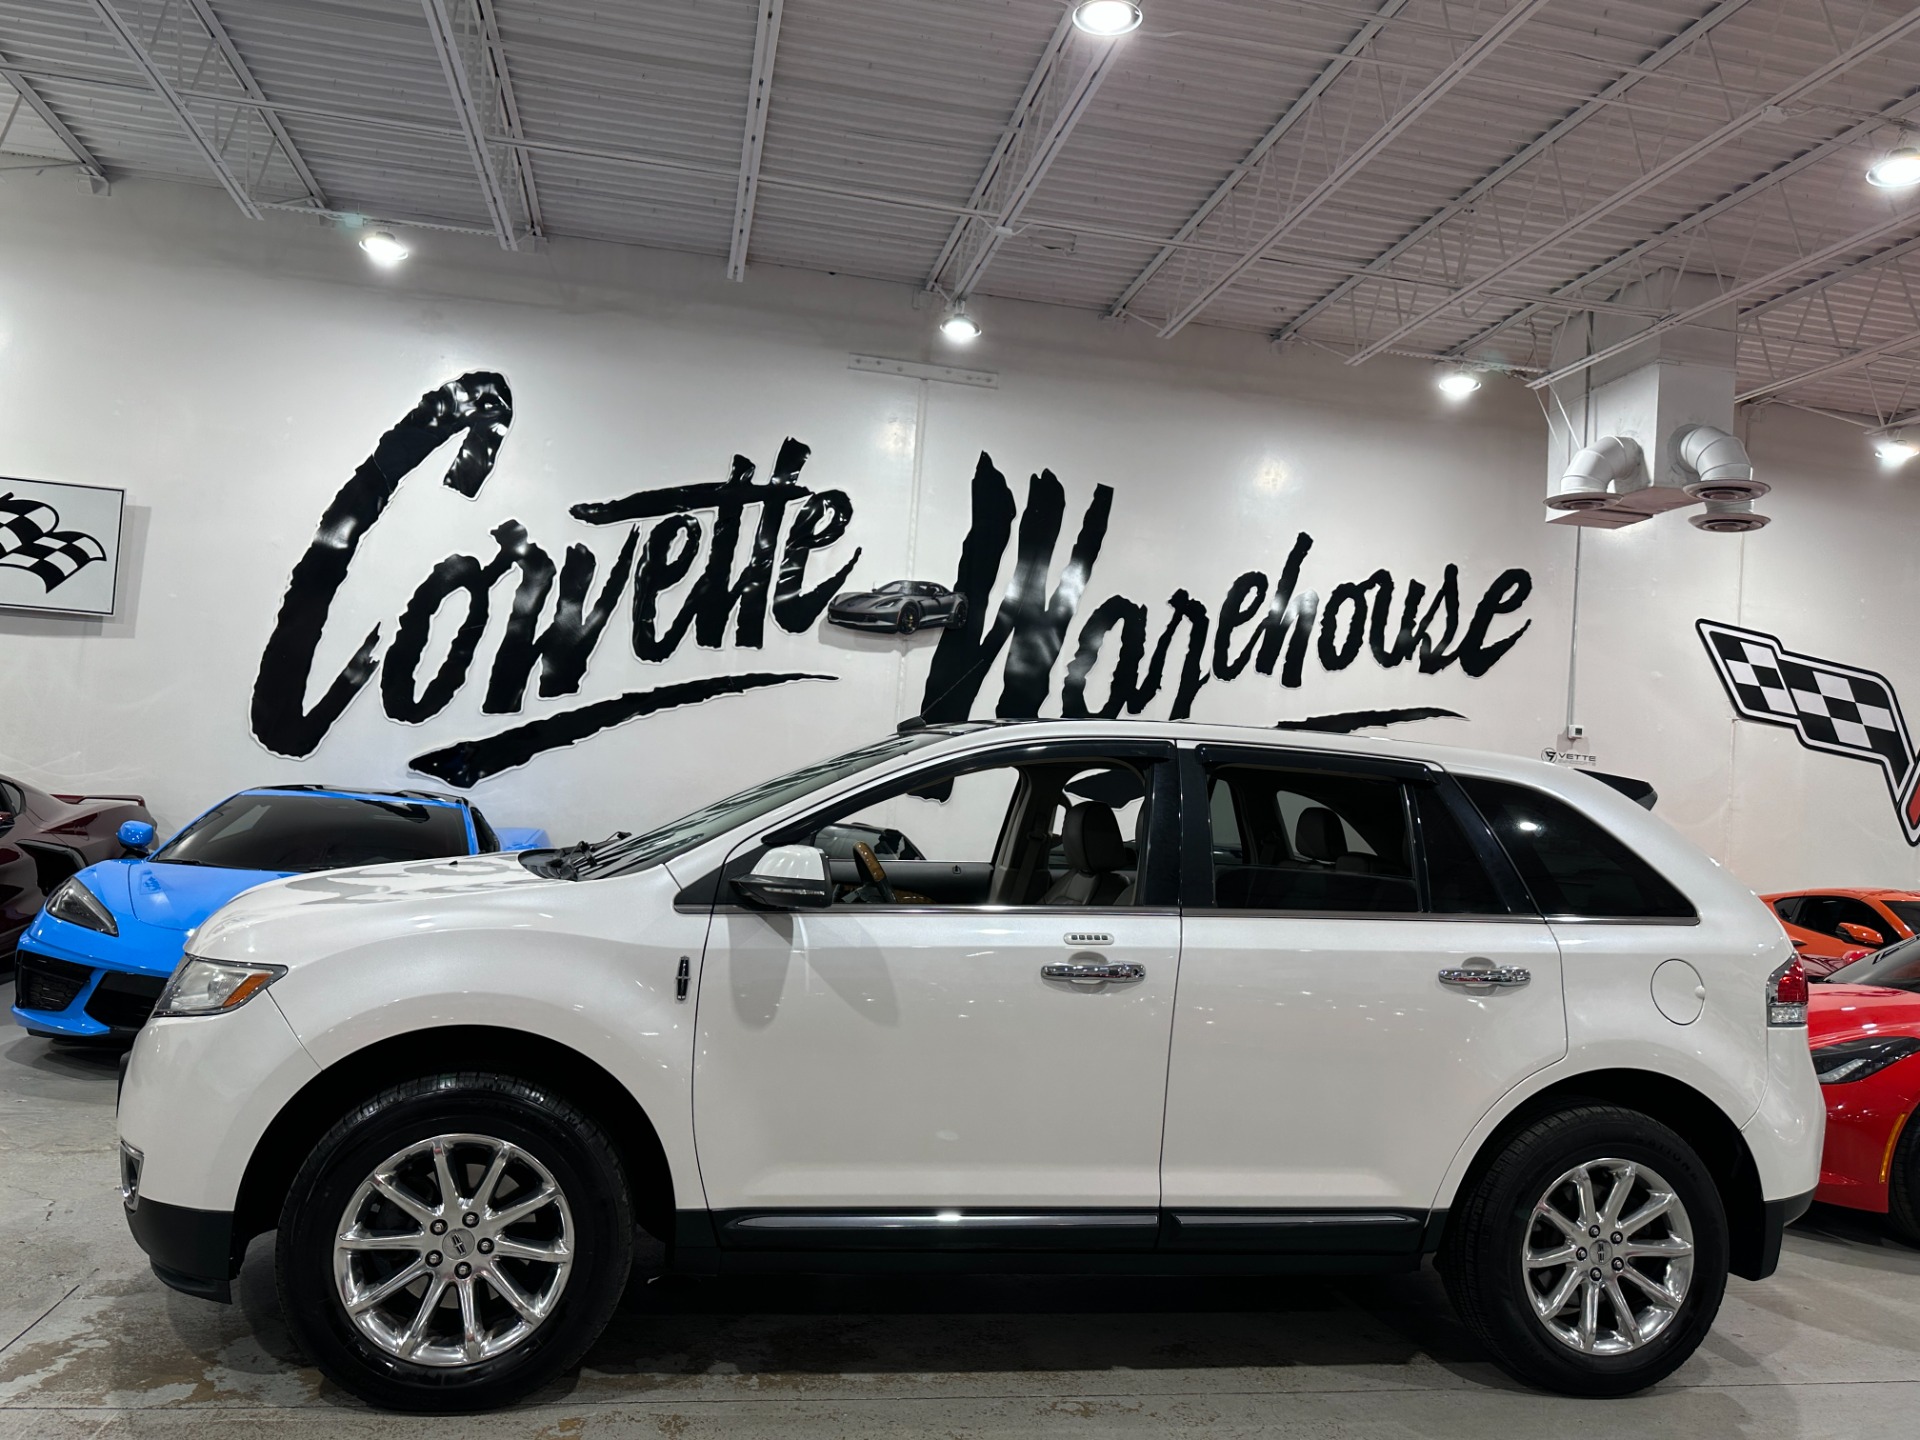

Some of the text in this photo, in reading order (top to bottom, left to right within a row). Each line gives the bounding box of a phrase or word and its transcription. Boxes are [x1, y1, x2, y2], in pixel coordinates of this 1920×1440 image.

[250, 370, 1533, 760] Corvette Warehouse
[1558, 752, 1597, 762] VETTE
